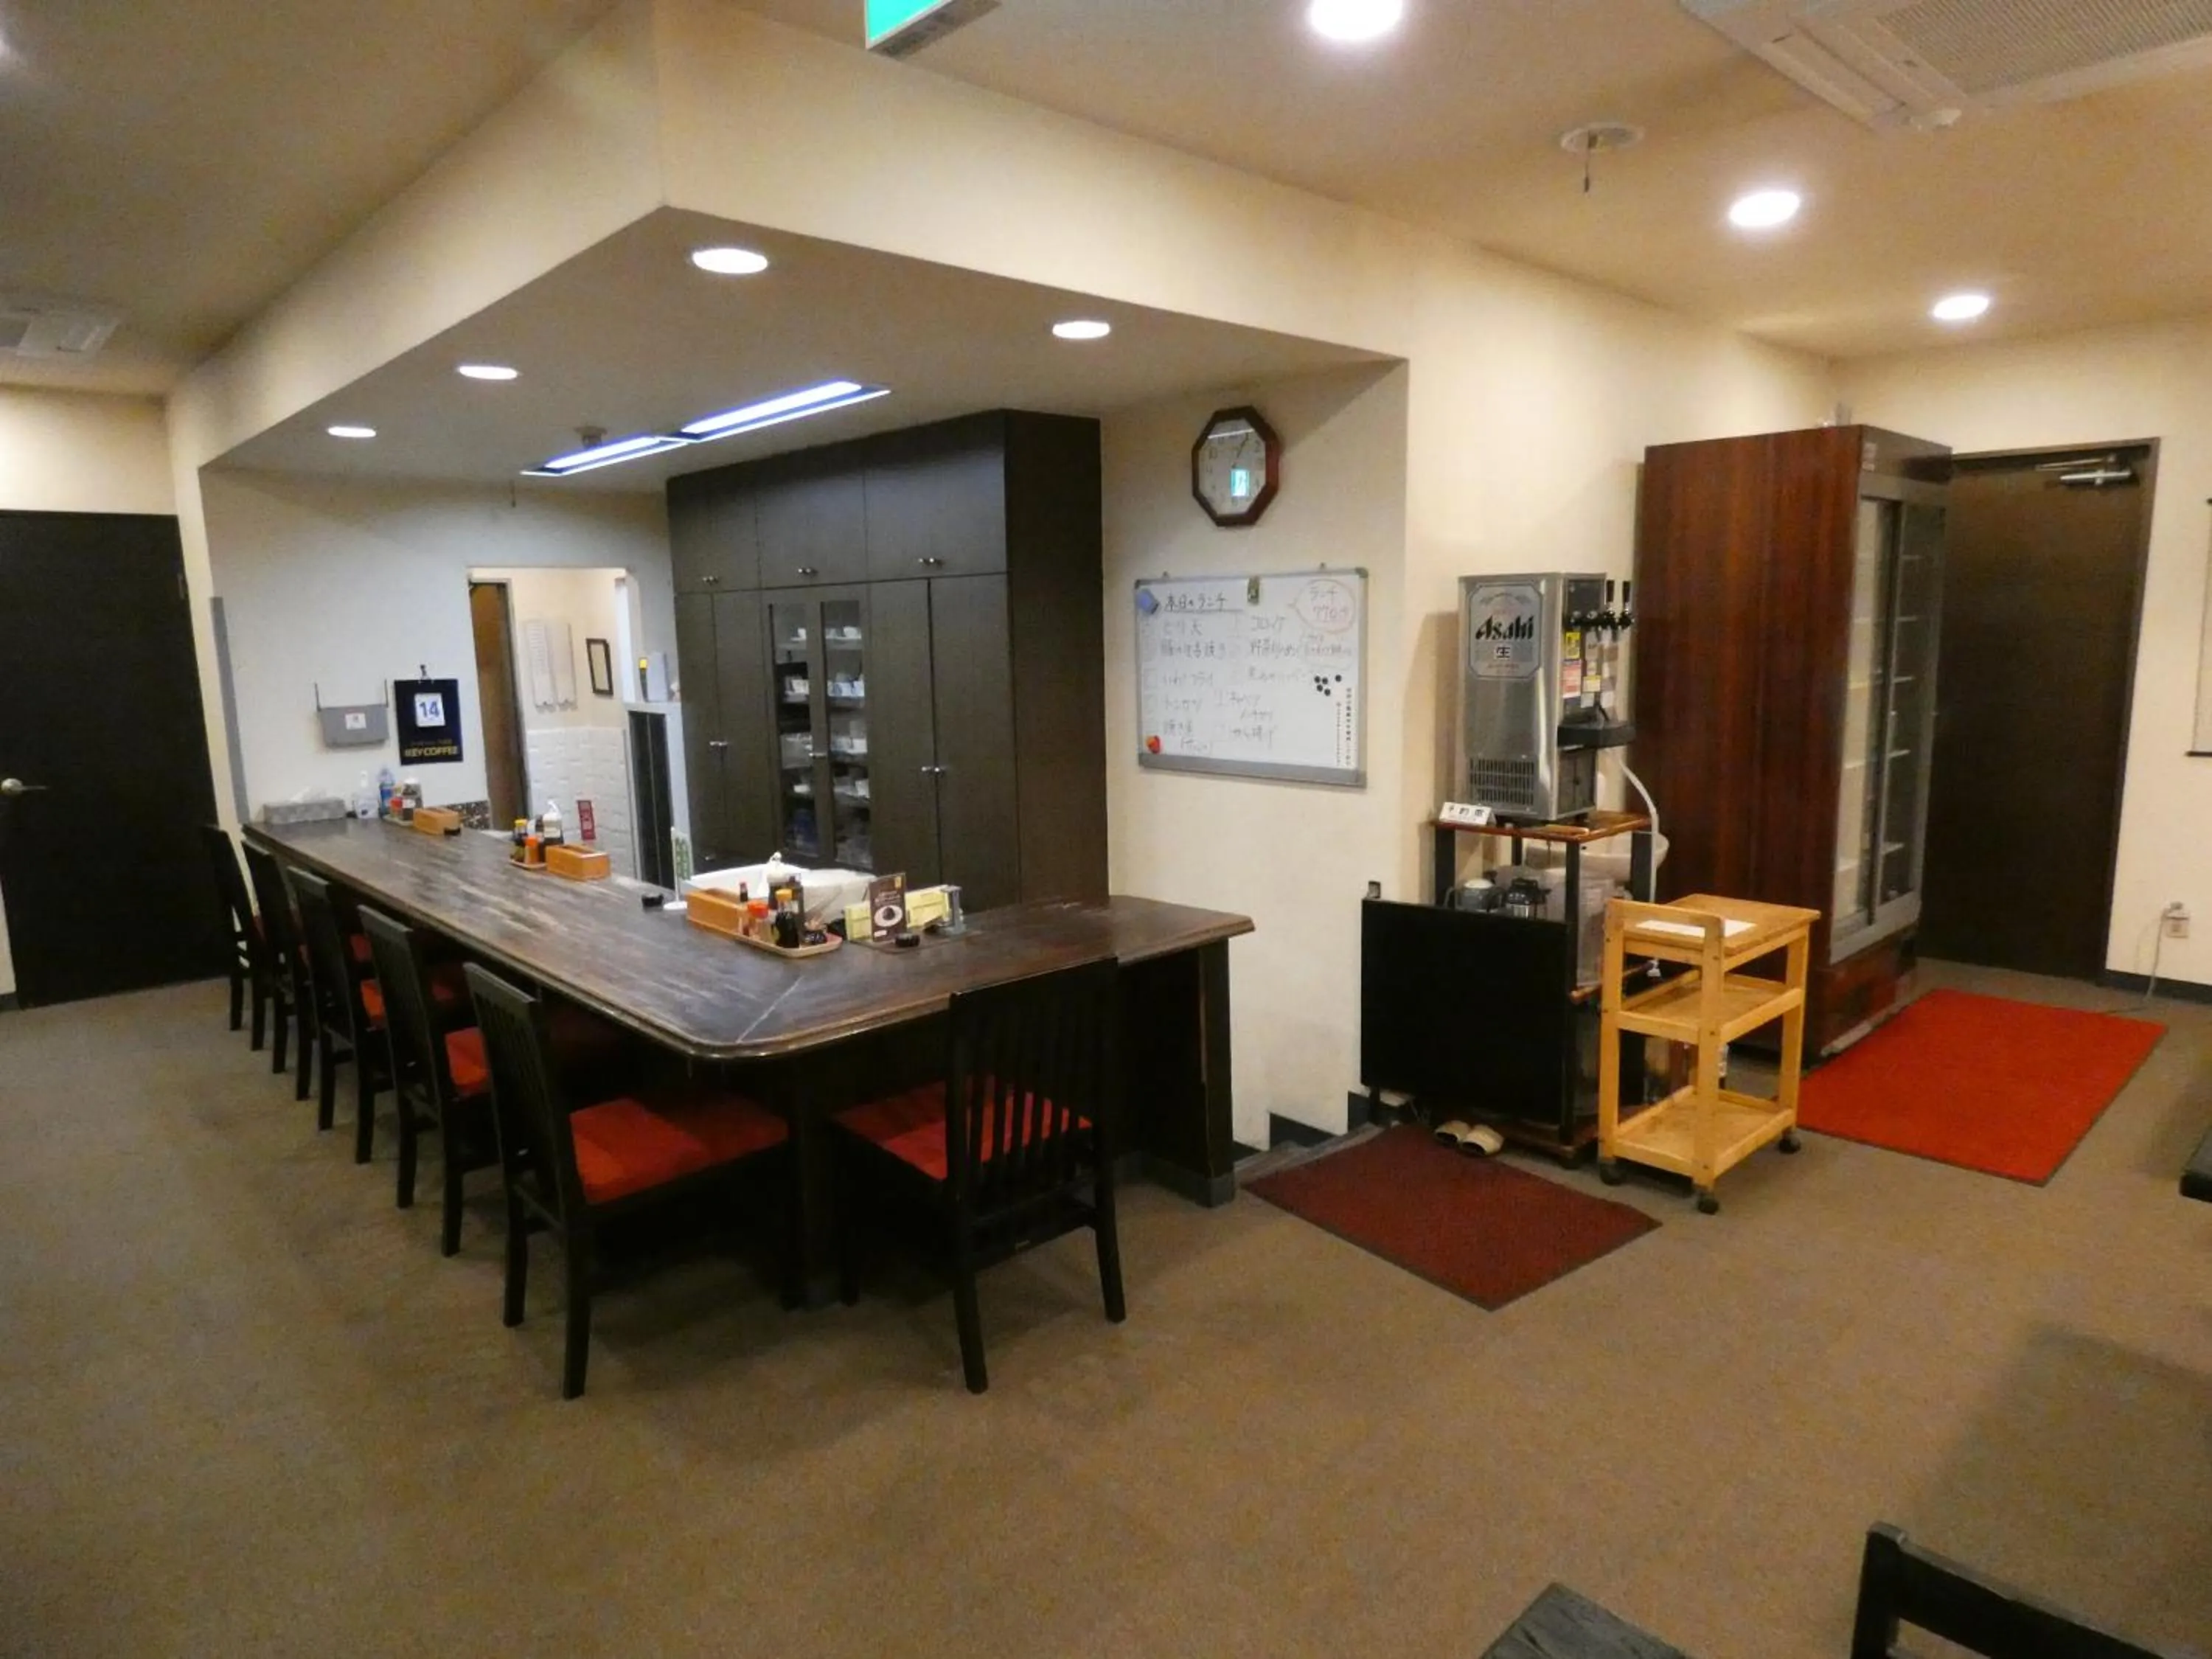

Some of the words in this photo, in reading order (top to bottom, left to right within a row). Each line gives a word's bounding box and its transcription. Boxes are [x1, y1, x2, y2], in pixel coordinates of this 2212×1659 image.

[1475, 615, 1534, 640] Asahi
[1496, 647, 1511, 658] 生
[419, 701, 440, 718] 14
